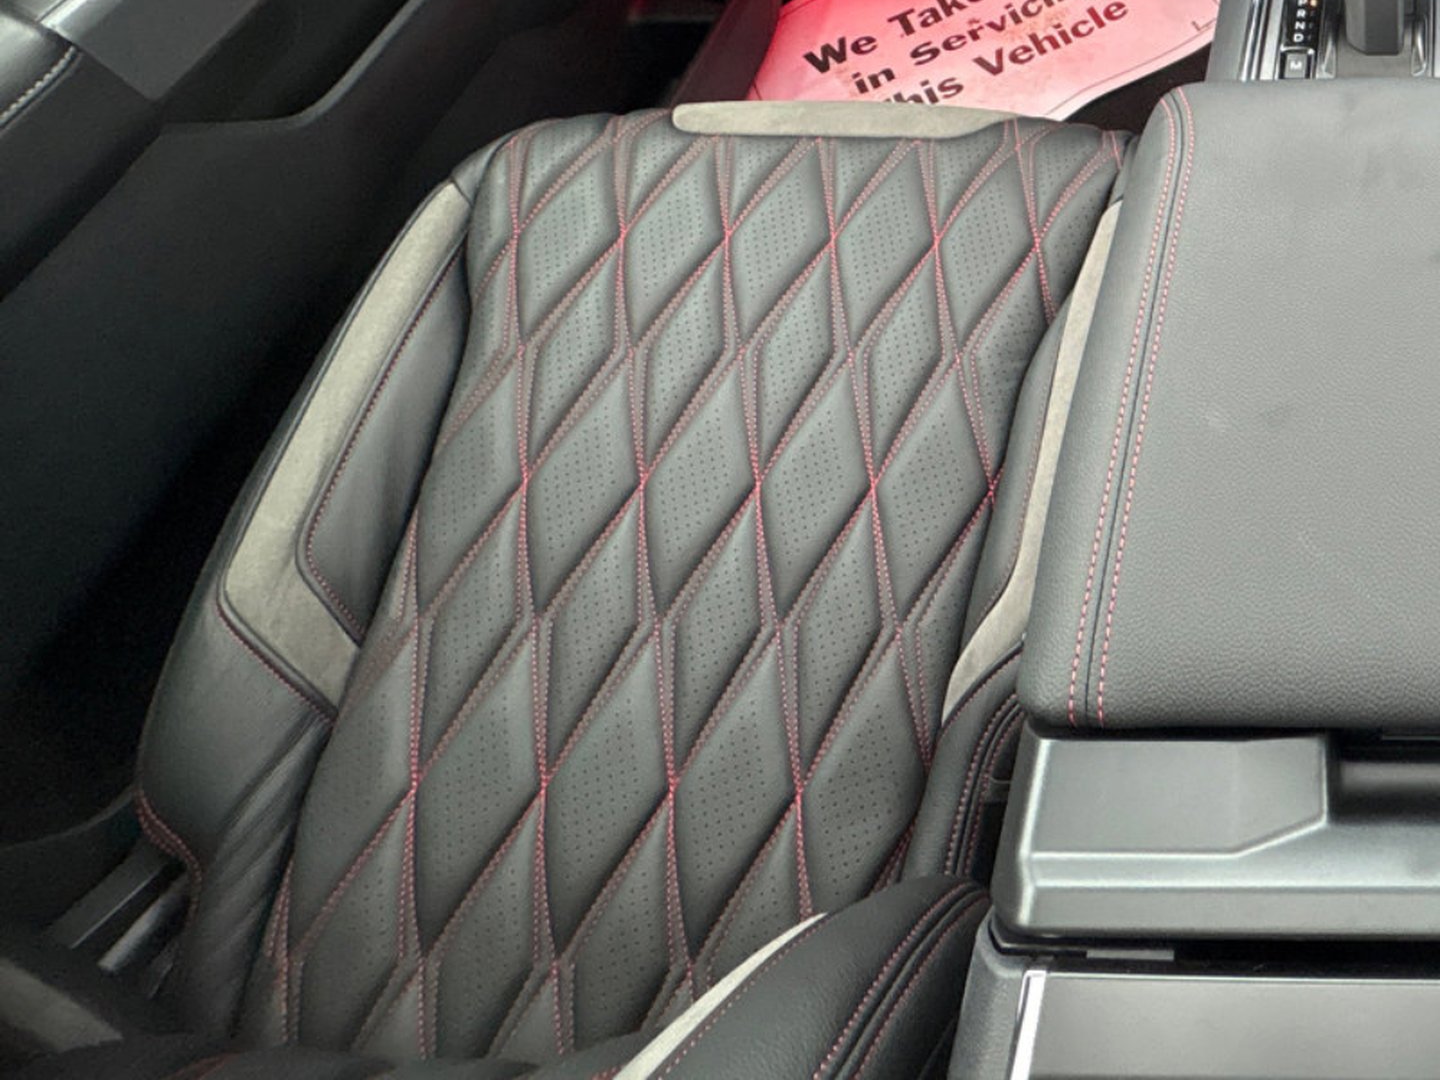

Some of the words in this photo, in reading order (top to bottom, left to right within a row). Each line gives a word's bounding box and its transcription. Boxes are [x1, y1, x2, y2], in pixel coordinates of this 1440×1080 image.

[1296, 8, 1306, 18] R
[1294, 21, 1306, 30] N
[1293, 33, 1304, 43] D
[803, 35, 878, 74] We
[884, 77, 964, 105] his
[972, 0, 1129, 77] Vehicle
[1290, 60, 1302, 70] M
[851, 66, 895, 94] in
